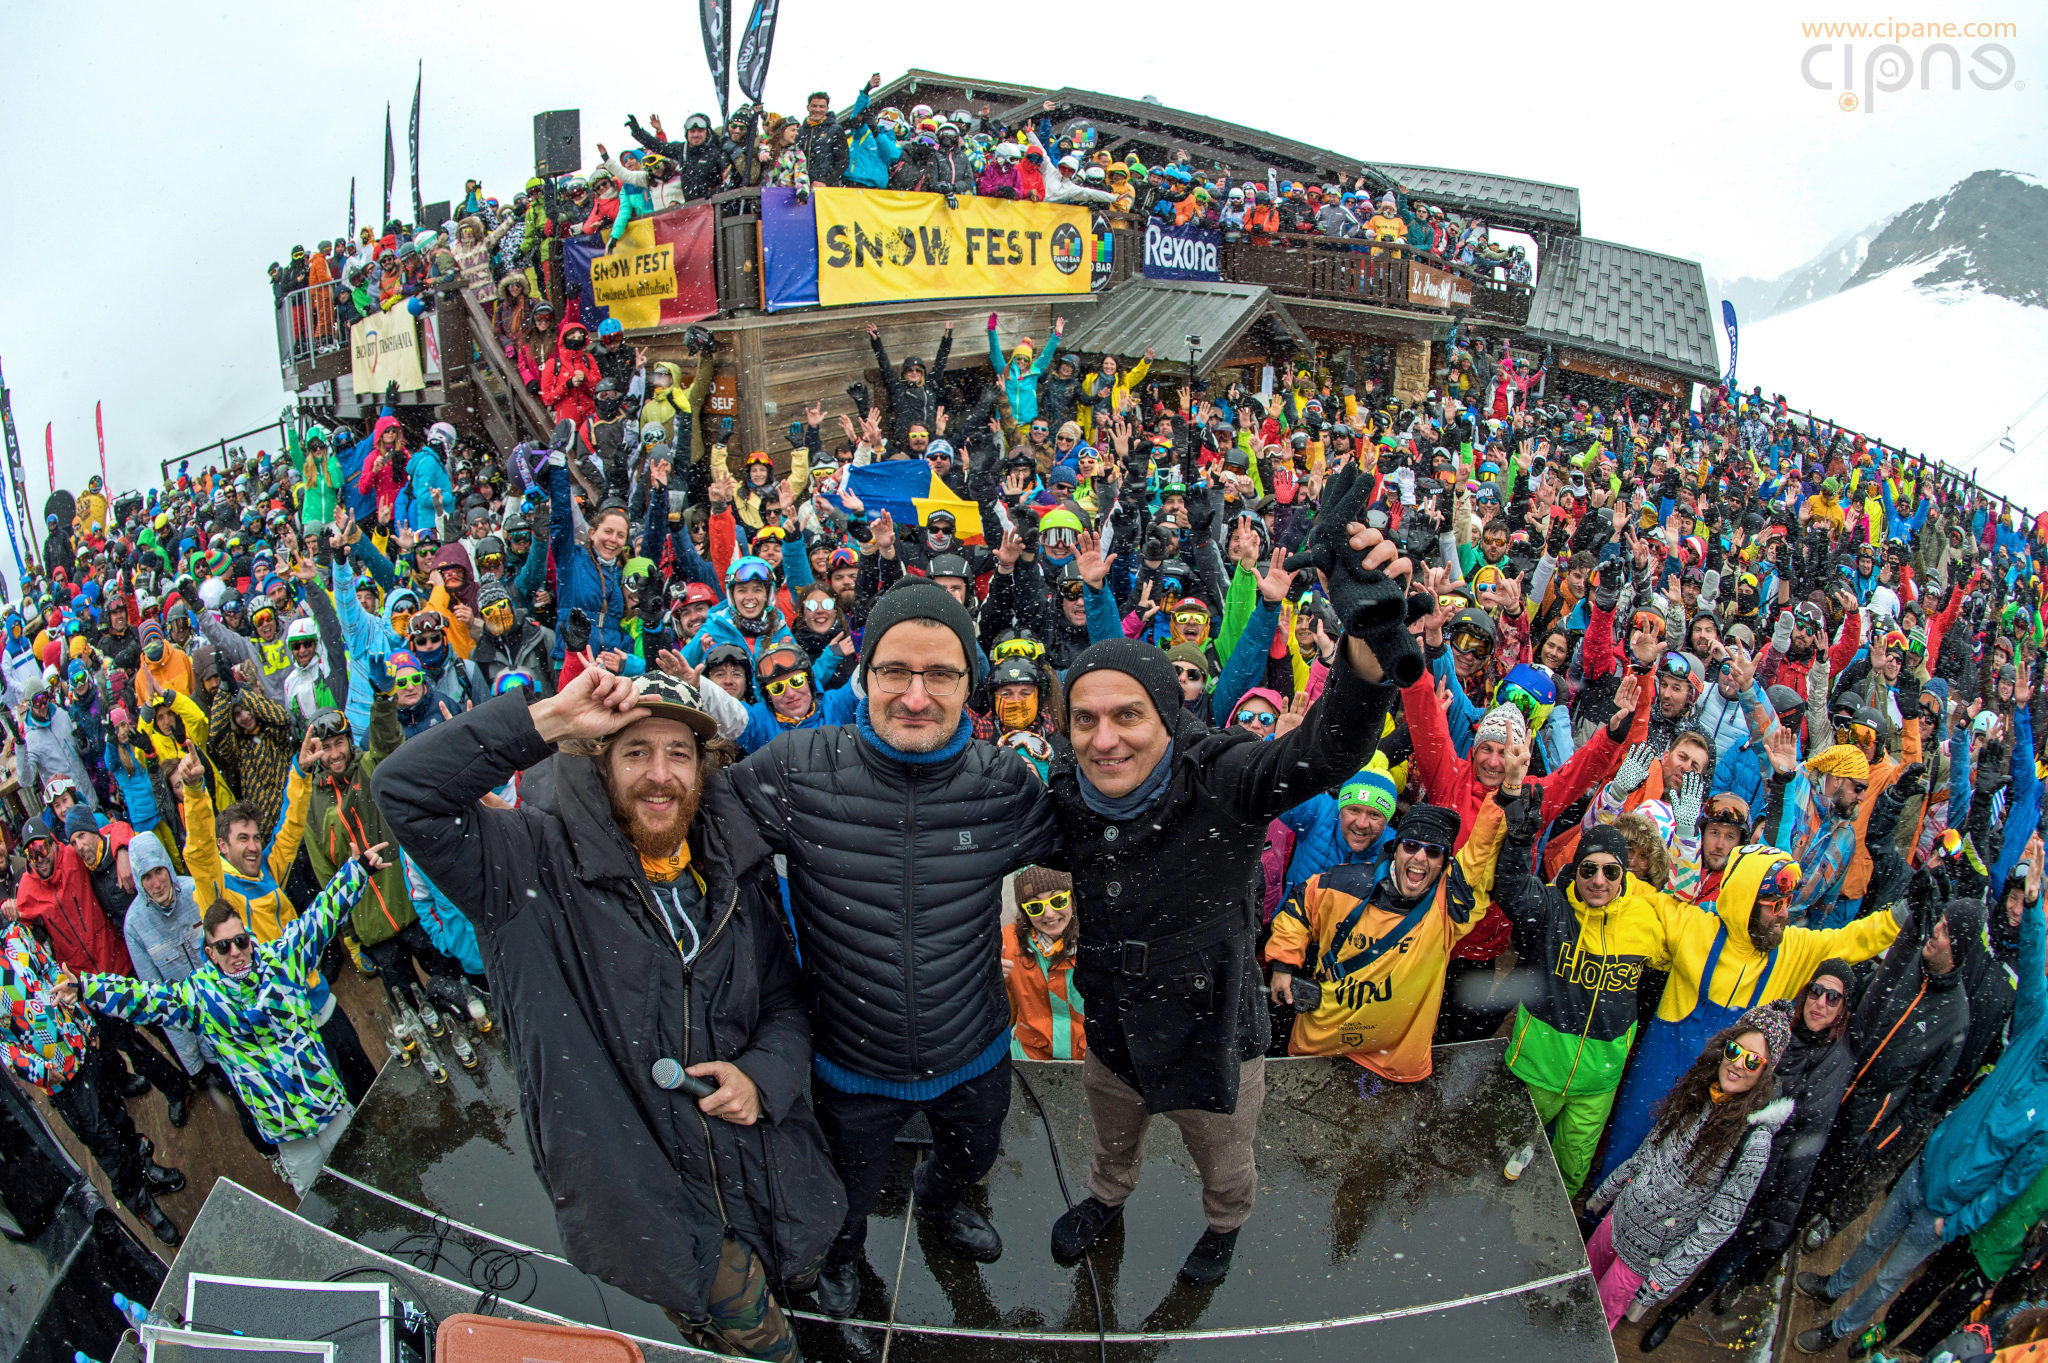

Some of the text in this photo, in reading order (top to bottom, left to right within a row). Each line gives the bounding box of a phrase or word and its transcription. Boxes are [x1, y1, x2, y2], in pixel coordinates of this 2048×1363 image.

[826, 220, 1043, 268] SNOW FEST
[1144, 224, 1217, 272] Rexona
[593, 250, 670, 281] SNOW FEST
[1053, 255, 1068, 263] PANO
[1095, 262, 1112, 273] BAR
[711, 396, 735, 410] SELF
